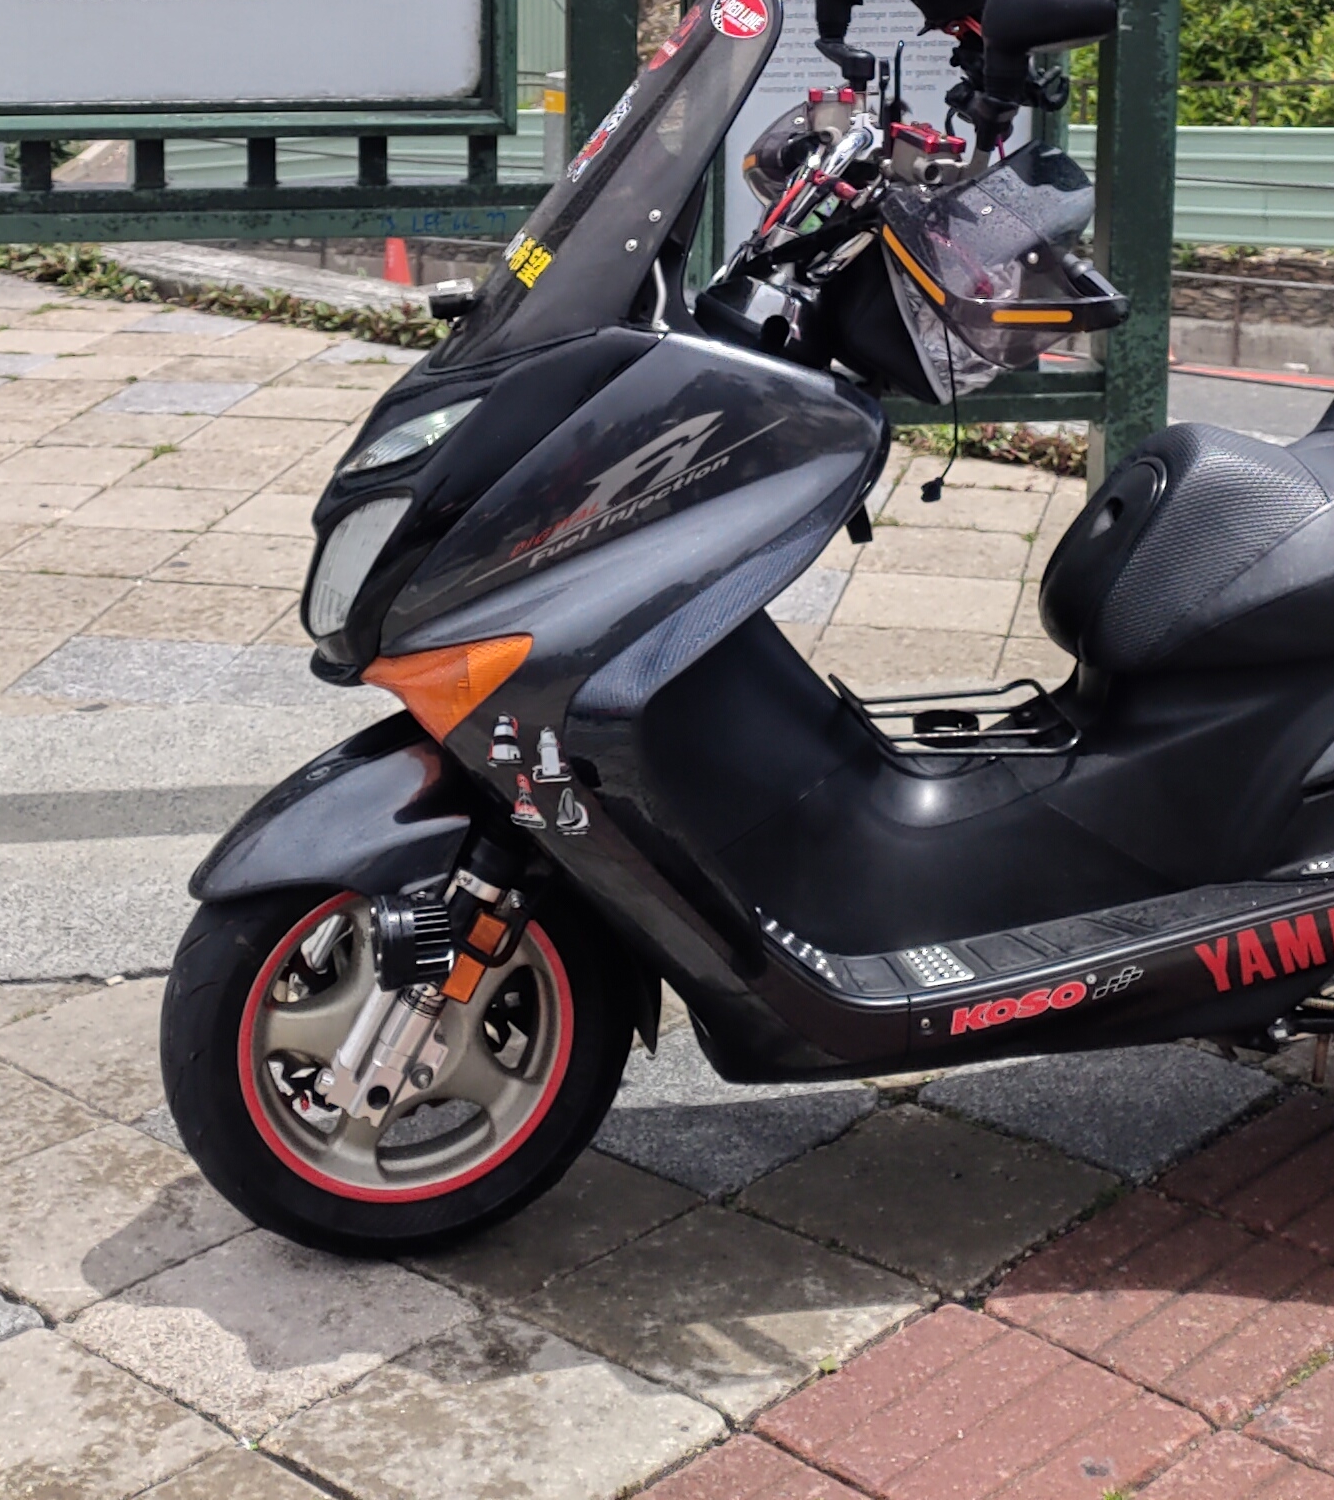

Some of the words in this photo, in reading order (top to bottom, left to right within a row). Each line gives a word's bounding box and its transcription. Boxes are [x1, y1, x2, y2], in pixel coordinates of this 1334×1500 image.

[738, 7, 765, 32] LINE
[509, 501, 600, 560] DIGITAL
[528, 526, 592, 569] Fuel
[596, 455, 731, 531] Injection
[949, 981, 1089, 1036] KOSO
